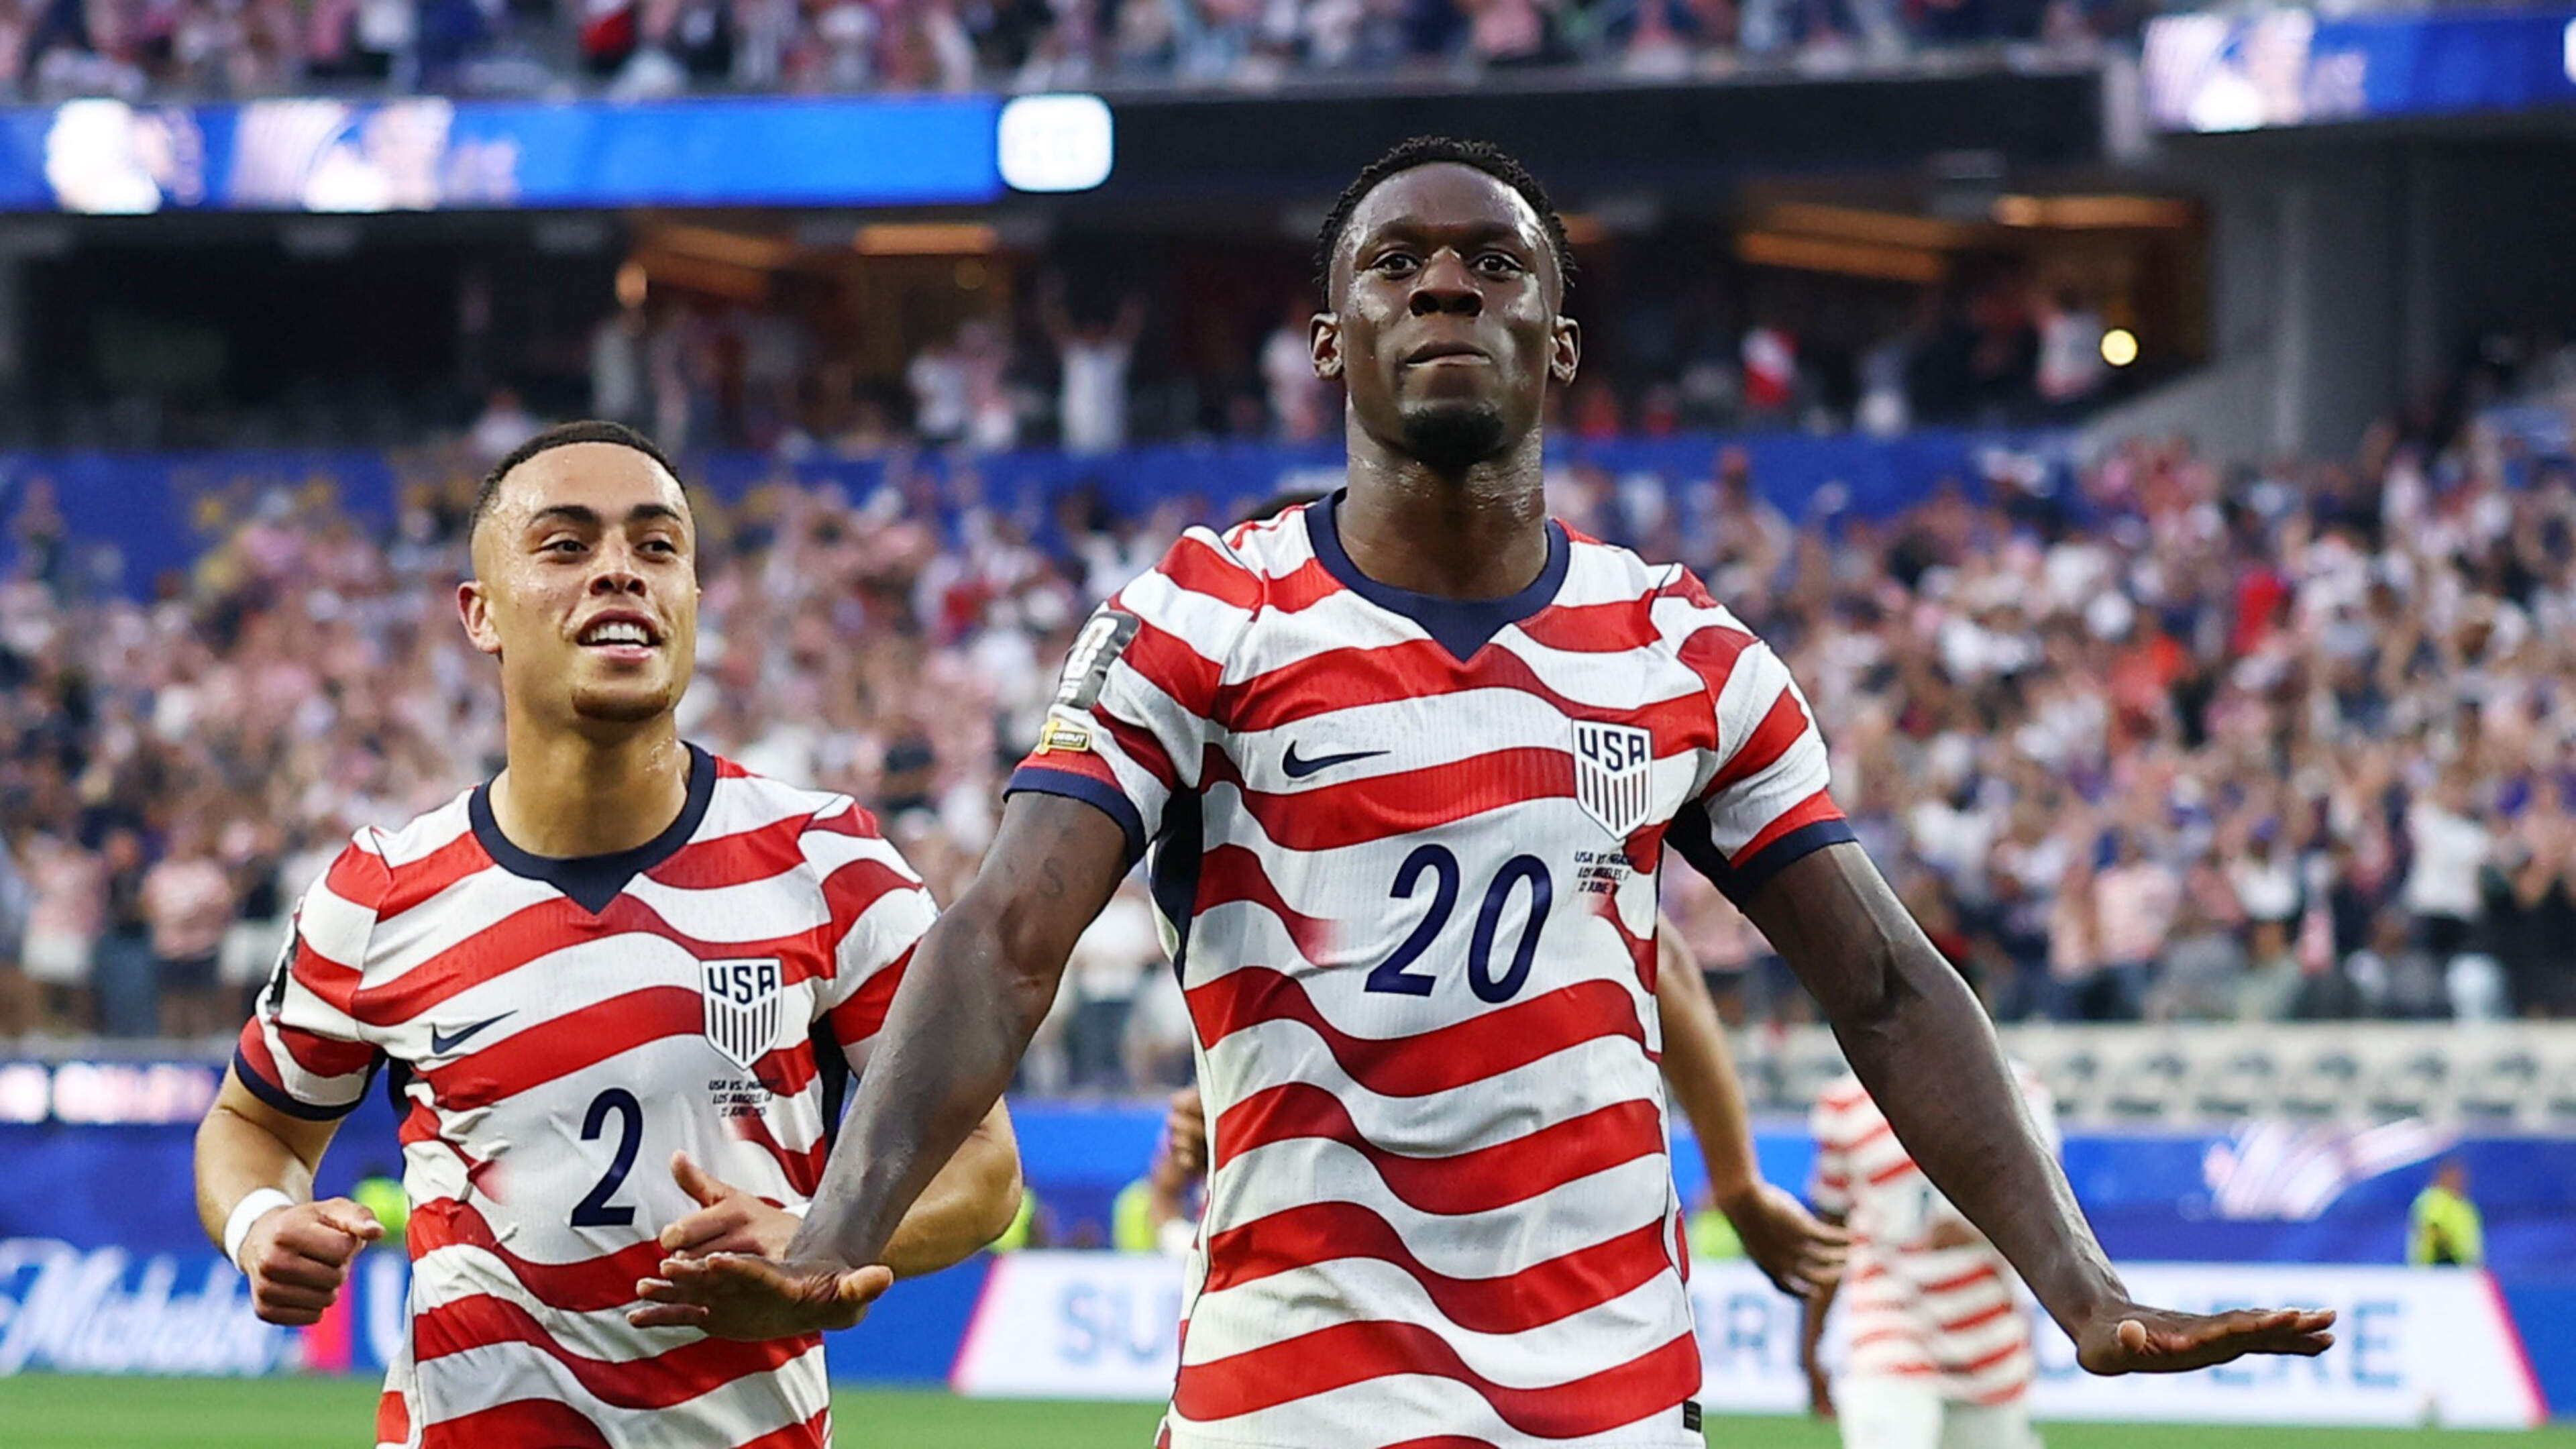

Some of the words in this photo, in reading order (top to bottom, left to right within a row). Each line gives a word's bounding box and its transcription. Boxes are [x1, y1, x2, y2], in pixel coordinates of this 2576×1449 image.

[1578, 727, 1645, 772] USA
[1574, 851, 1593, 864] USA
[1364, 843, 1553, 1004] 20
[708, 965, 775, 1005] USA
[570, 1087, 643, 1228] 2
